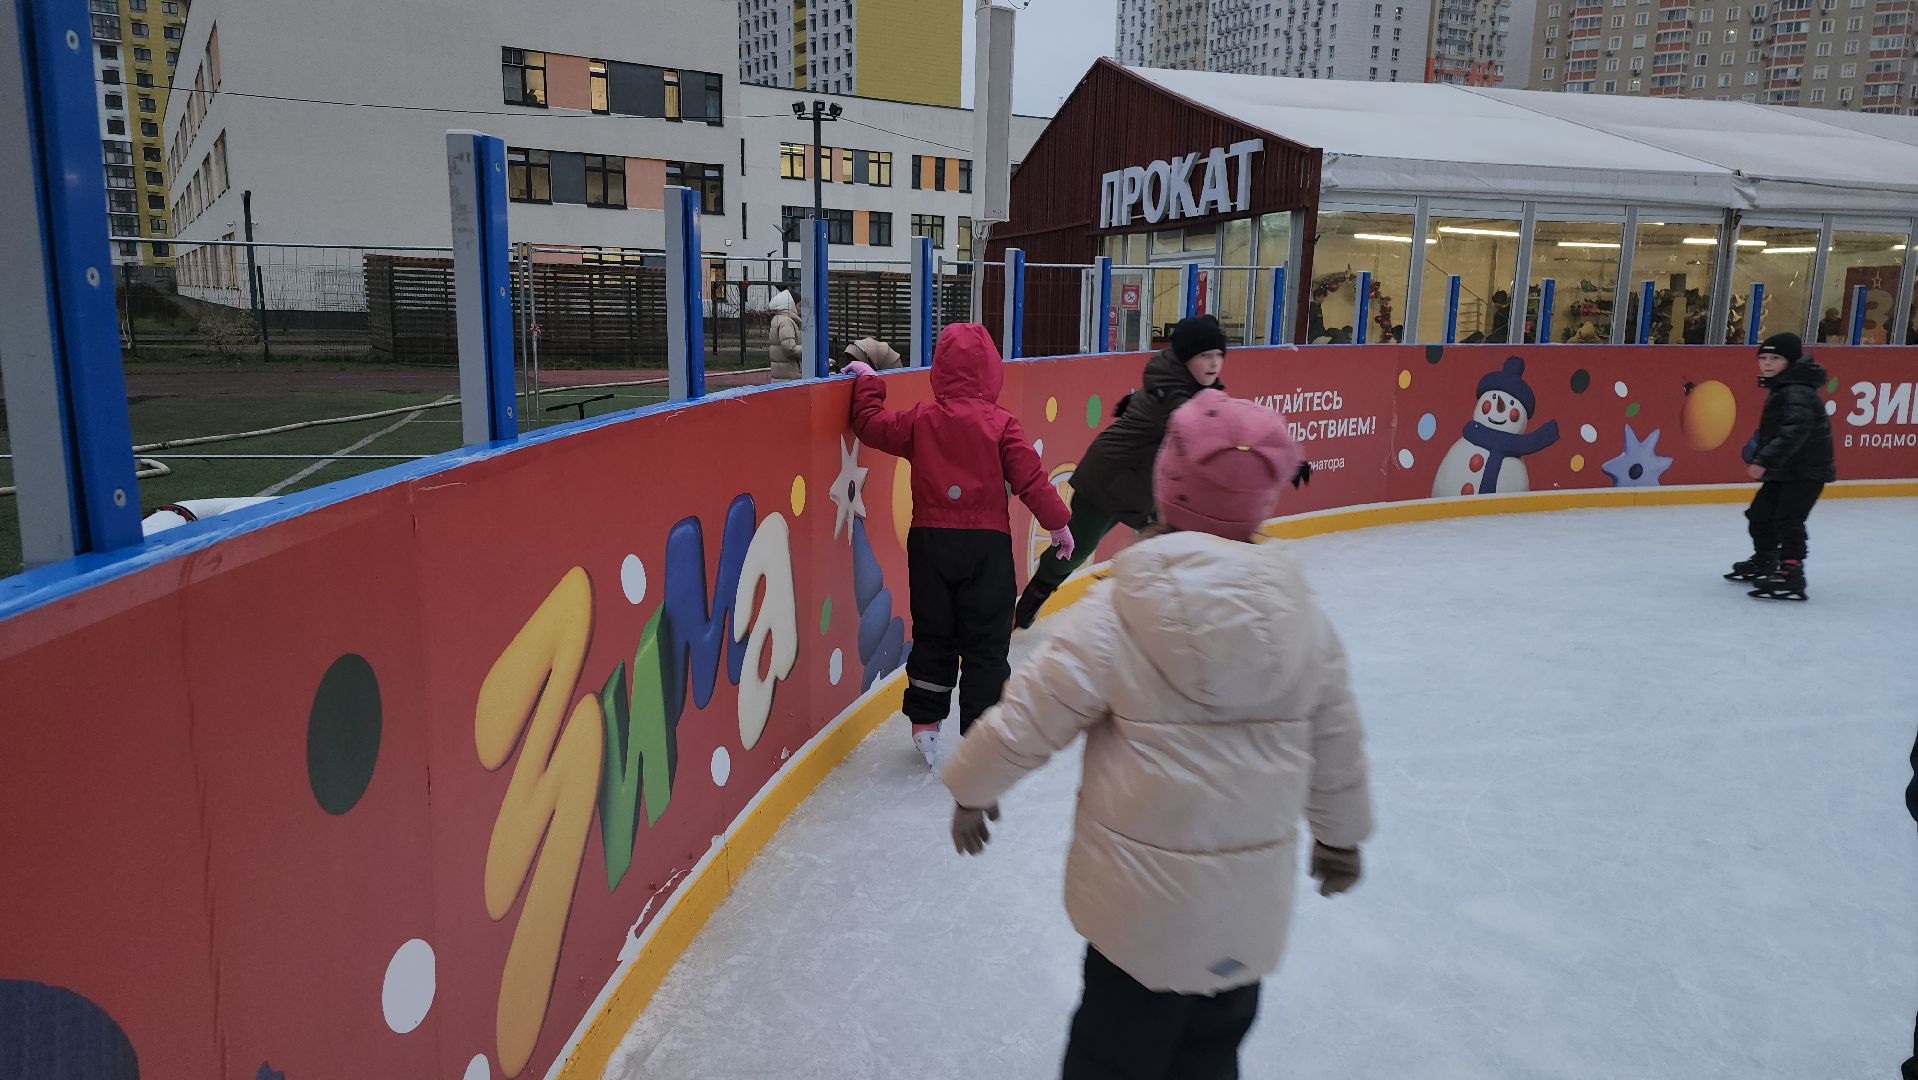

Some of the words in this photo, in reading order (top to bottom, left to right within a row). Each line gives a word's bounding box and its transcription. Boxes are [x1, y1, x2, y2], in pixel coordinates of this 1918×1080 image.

[1100, 138, 1264, 228] ПРОКАТ
[1288, 415, 1377, 442] ЛЬСТВИЕМ!
[1860, 434, 1917, 448] ПОДМО
[1308, 457, 1345, 473] натора
